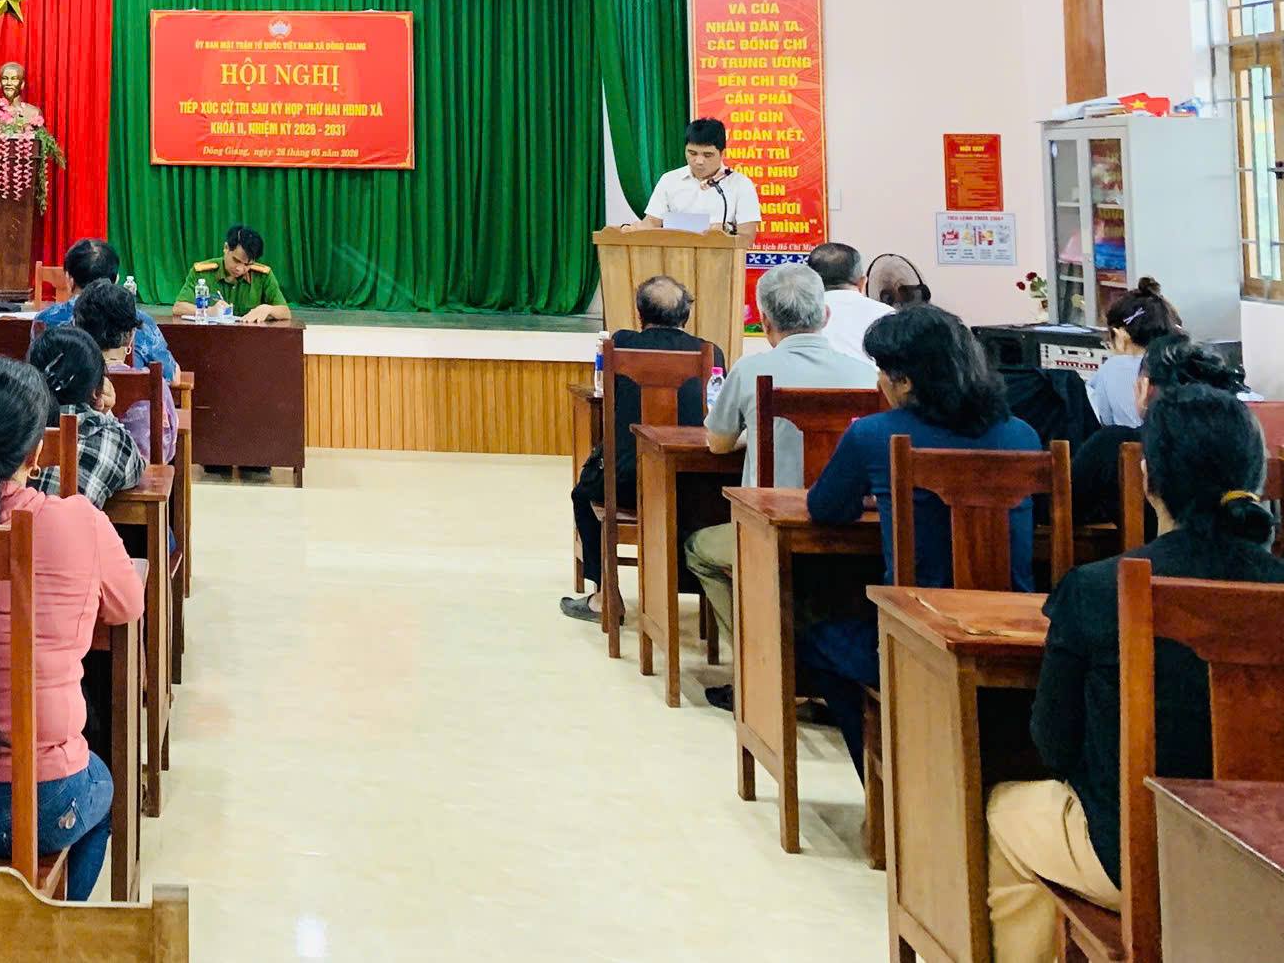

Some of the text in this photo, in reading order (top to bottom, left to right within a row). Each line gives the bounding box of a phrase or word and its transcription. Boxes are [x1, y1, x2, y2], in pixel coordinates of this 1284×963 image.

[728, 1, 747, 14] VÀ
[706, 20, 746, 33] NHÂN
[722, 57, 767, 68] TRUNG
[220, 57, 340, 92] HỘI NGHỊ
[179, 98, 198, 114] TIẾP
[235, 102, 249, 114] TRI
[251, 102, 269, 115] SAU
[325, 103, 341, 115] HAI
[767, 165, 799, 178] NHƯ
[760, 183, 786, 196] GÌN
